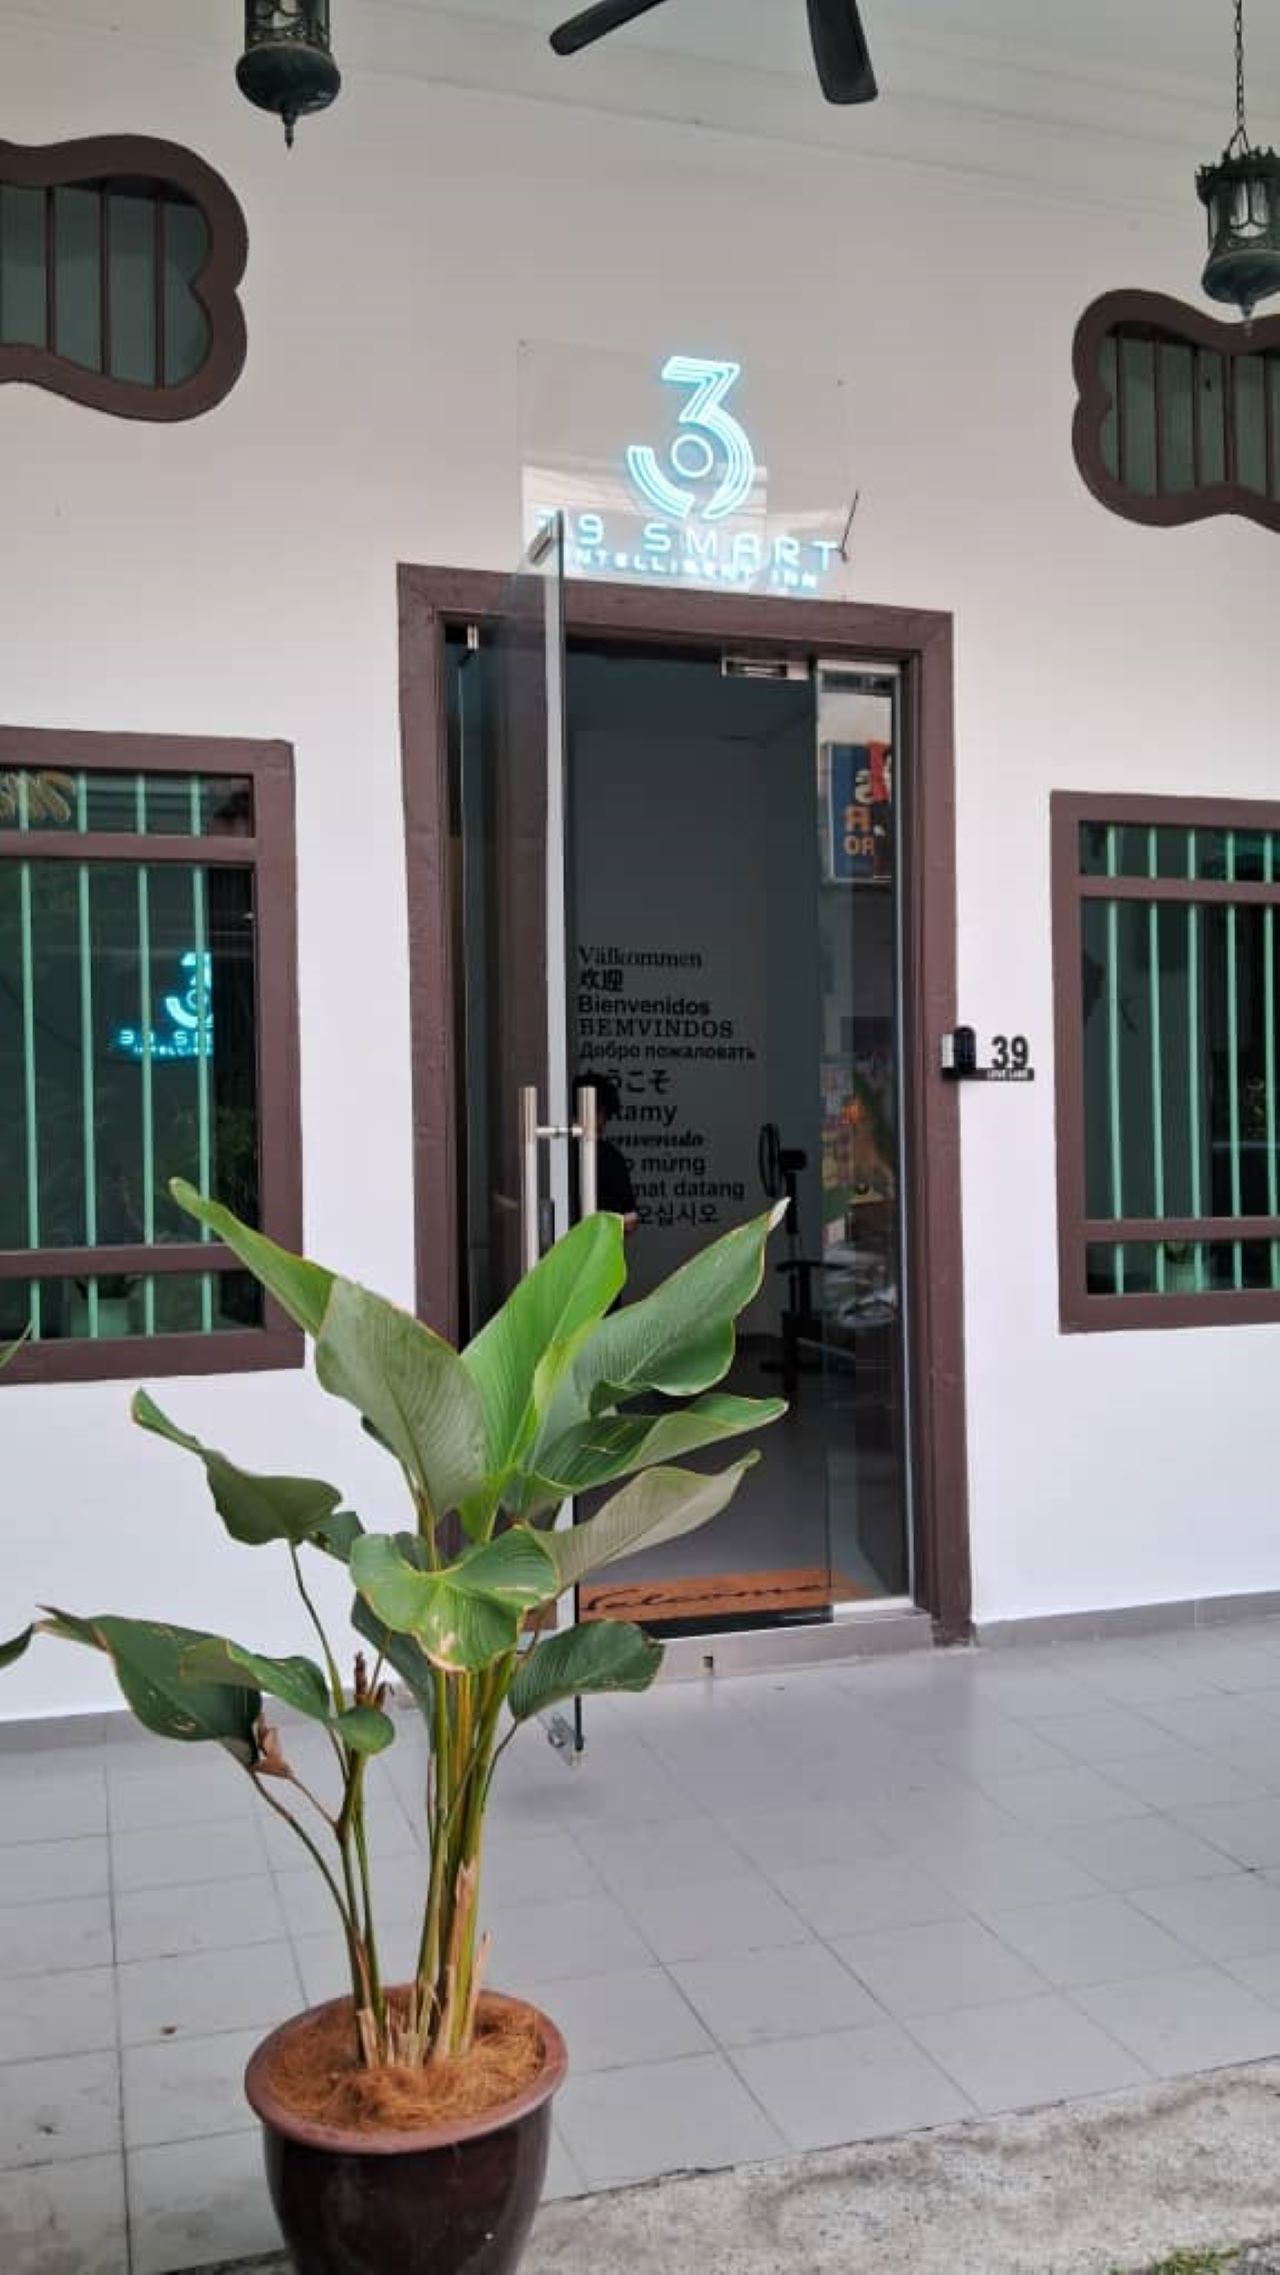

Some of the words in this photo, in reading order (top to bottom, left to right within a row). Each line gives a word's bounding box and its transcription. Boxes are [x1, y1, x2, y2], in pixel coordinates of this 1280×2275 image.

[643, 522, 840, 572] SMART
[578, 995, 710, 1016] Bienvenidos
[579, 1018, 733, 1039] BEMVINDOS
[579, 1041, 640, 1061] Добро
[991, 1035, 1029, 1069] 39
[674, 1181, 745, 1201] datang
